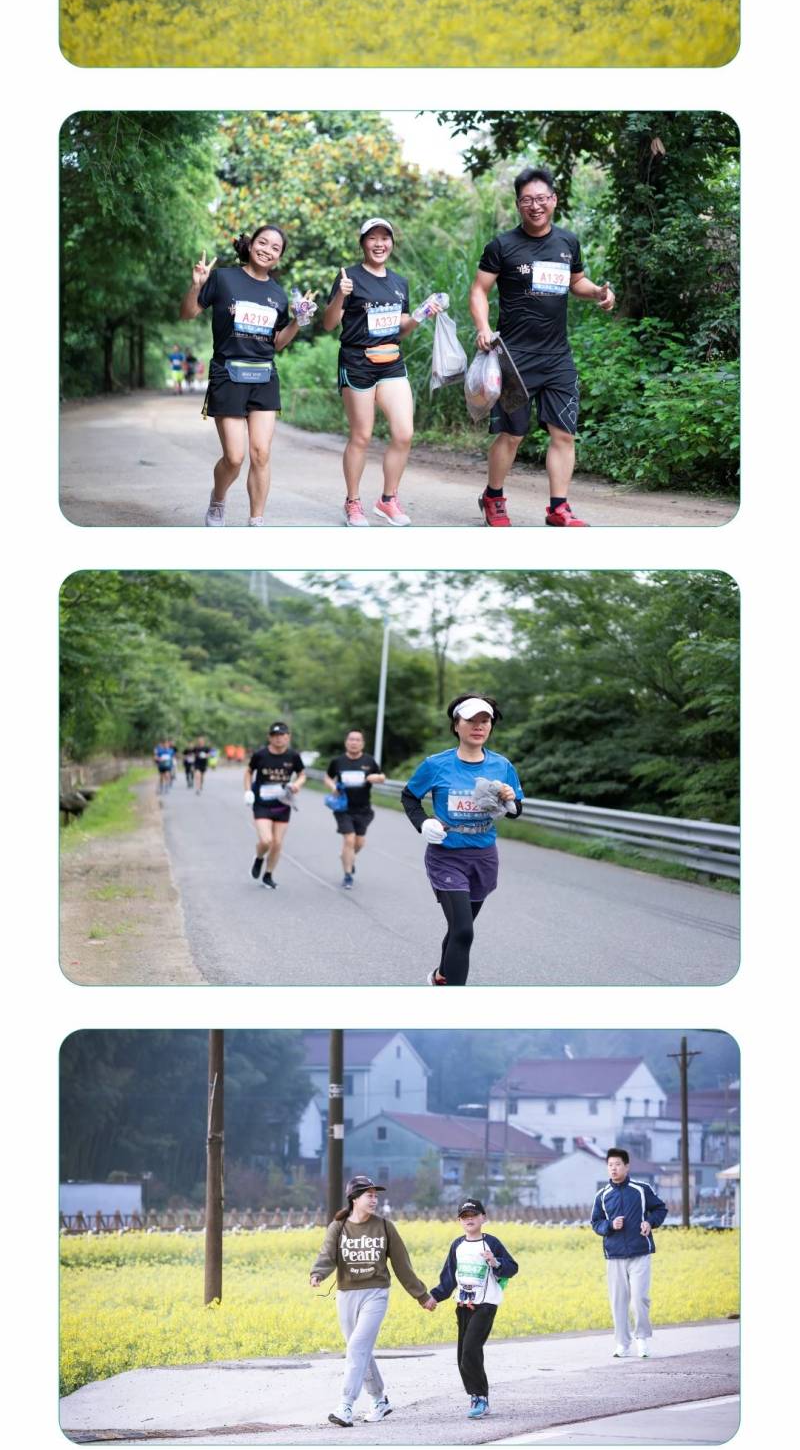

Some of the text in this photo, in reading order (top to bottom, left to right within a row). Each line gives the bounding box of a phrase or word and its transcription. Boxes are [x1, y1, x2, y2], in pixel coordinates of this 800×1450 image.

[242, 312, 269, 326] A219
[340, 1234, 384, 1249] Perfect
[341, 1247, 381, 1262] Pearls
